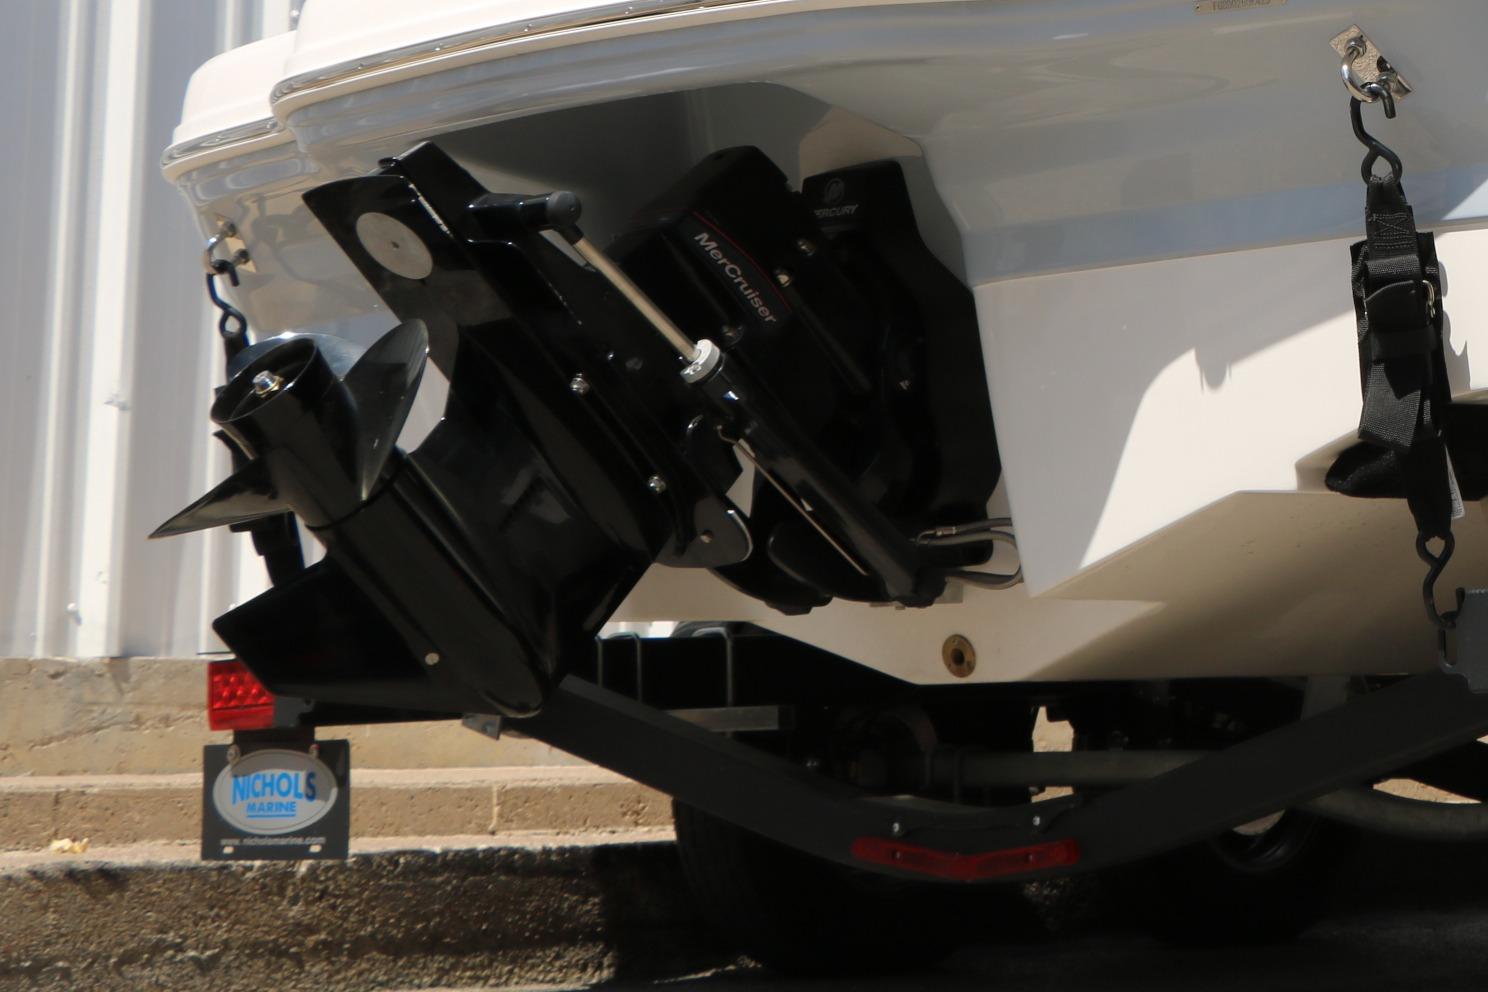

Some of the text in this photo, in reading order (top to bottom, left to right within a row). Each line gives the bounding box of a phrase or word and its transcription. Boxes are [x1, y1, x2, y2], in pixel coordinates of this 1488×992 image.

[814, 203, 859, 219] ERCURY
[693, 232, 776, 323] MerCruiser
[231, 770, 317, 806] NICHOLS
[246, 801, 297, 813] MARINE
